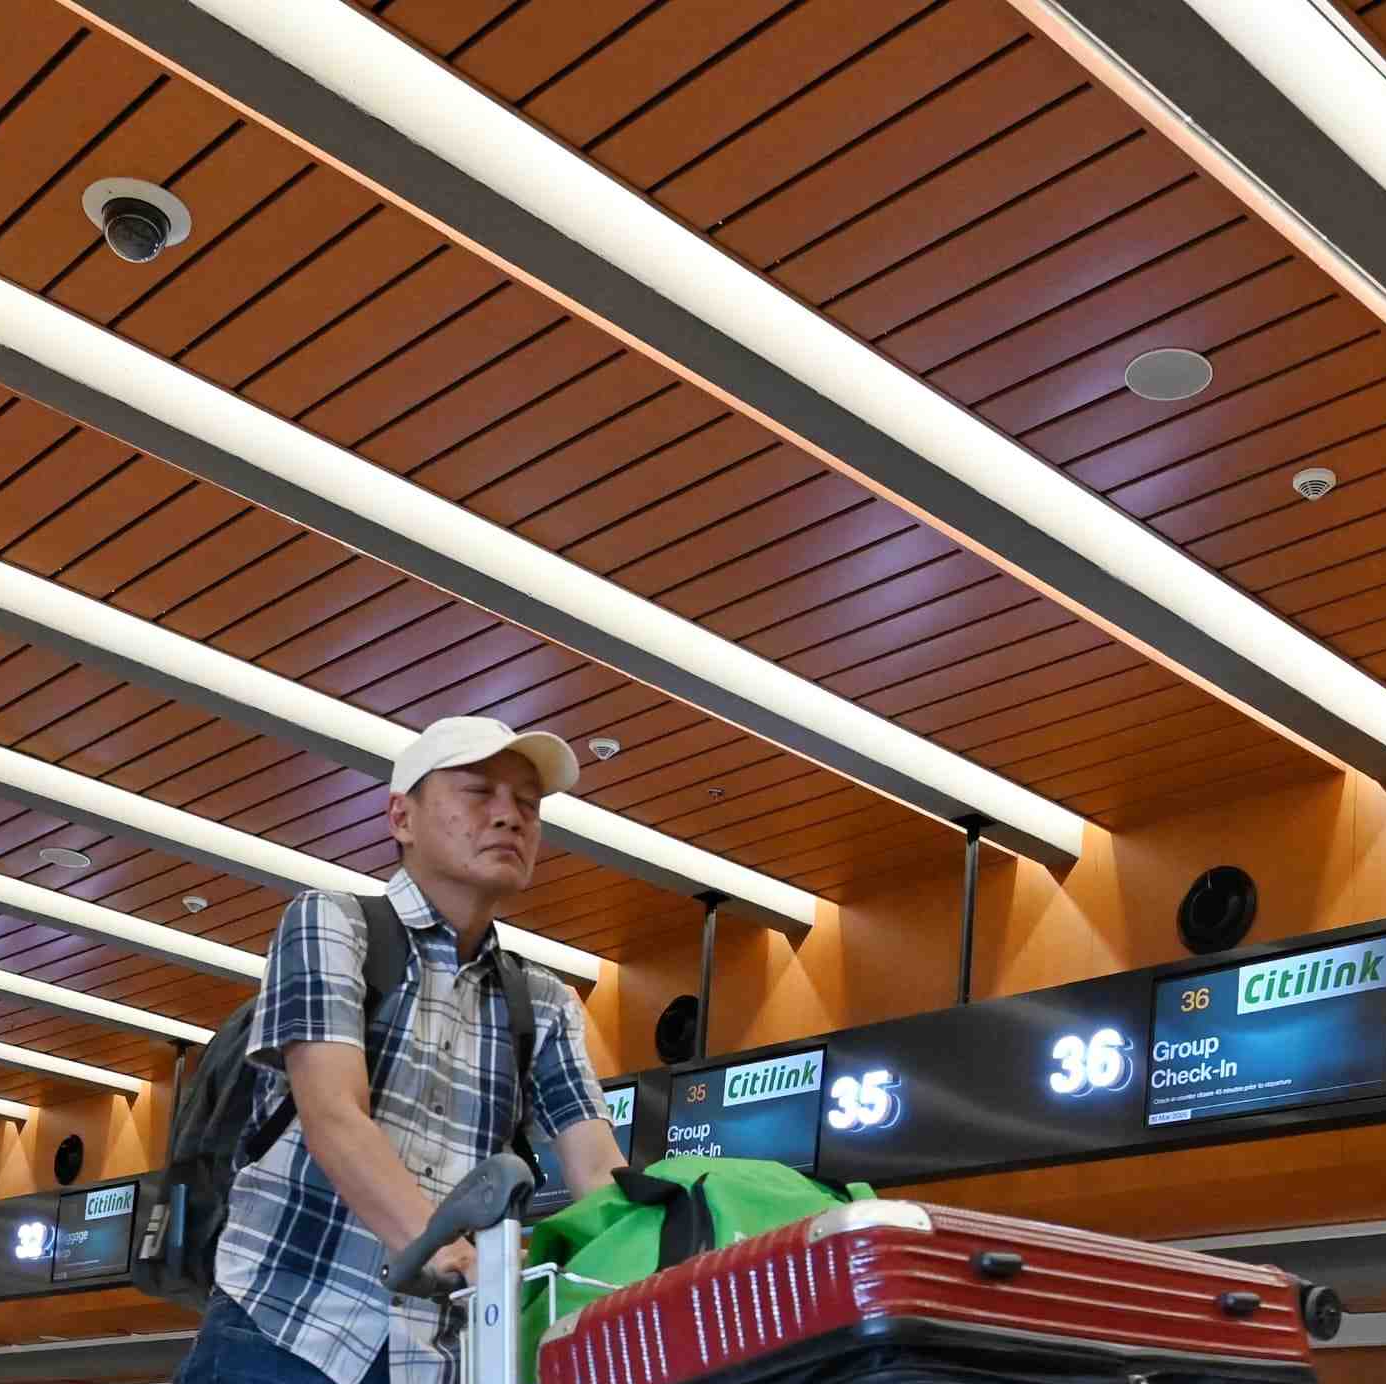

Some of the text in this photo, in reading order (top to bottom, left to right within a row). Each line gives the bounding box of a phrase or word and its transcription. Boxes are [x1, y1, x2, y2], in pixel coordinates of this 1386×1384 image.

[1243, 950, 1386, 1005] Citilink
[1180, 988, 1211, 1014] 36
[1049, 1028, 1127, 1094] 36
[1152, 1036, 1220, 1063] Group
[727, 1060, 817, 1099] Citilink
[1150, 1059, 1238, 1090] Check-In
[685, 1083, 707, 1104] 35
[827, 1069, 892, 1131] 35
[666, 1122, 711, 1143] Group
[87, 1192, 132, 1216] Citilink
